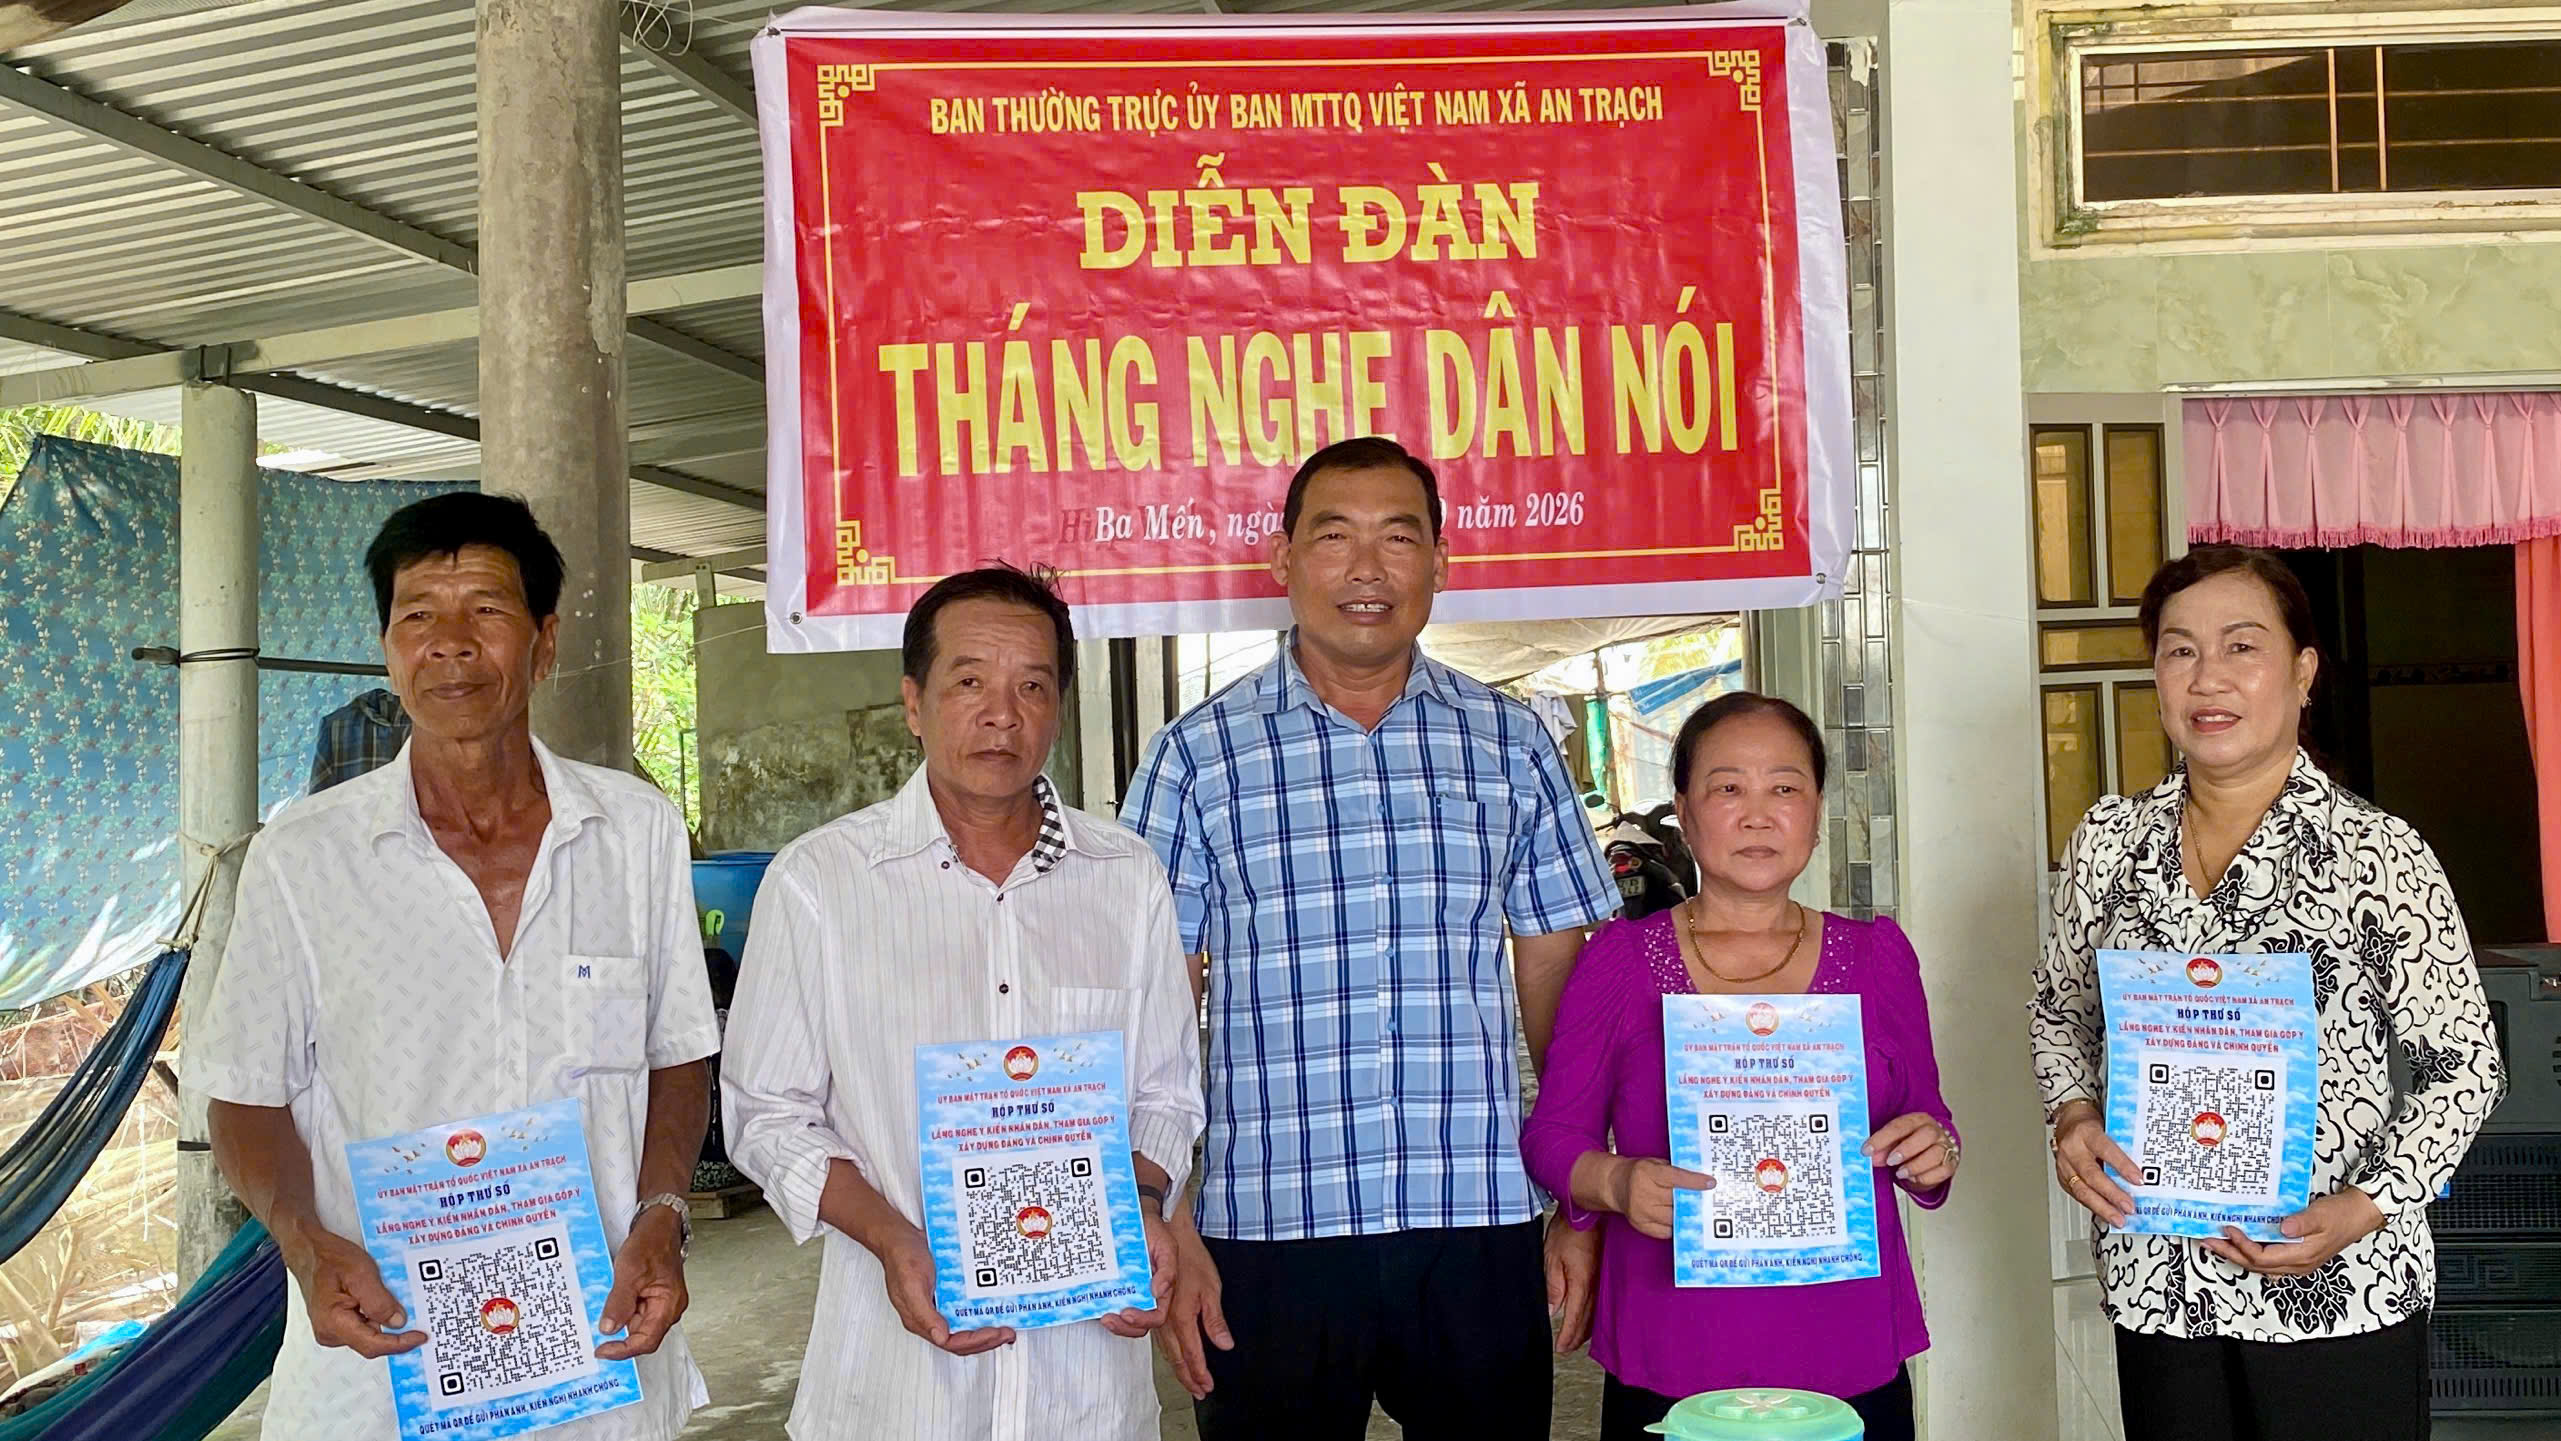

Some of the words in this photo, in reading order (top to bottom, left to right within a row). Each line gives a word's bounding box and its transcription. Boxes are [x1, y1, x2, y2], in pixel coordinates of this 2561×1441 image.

[931, 98, 985, 135] BAN
[993, 89, 1100, 133] THƯỜNG
[1109, 88, 1178, 138] TRỰC
[1188, 81, 1217, 130] ỦY
[1231, 93, 1284, 129] BAN
[1290, 93, 1361, 131] MTTQ
[1369, 81, 1424, 133] VIỆT
[1435, 89, 1490, 125] NAM
[1498, 80, 1532, 124] XÃ
[1540, 89, 1572, 122] AN
[1579, 87, 1663, 129] TRẠCH
[1076, 152, 1314, 270] DIỄN
[1339, 162, 1539, 264] ĐÀN
[878, 302, 1162, 477] THÁNG
[1187, 331, 1397, 467] NGHE
[1425, 290, 1585, 460] DÂN
[1610, 286, 1738, 455] NÓI
[1095, 507, 1132, 542] Ba
[1144, 497, 1216, 545] Mến,
[1227, 503, 1285, 545] ngà
[1457, 495, 1517, 529] năm
[1525, 492, 1584, 526] 2026
[2177, 1006, 2199, 1021] HỘP
[2202, 1008, 2224, 1020] THƯ
[2227, 1007, 2240, 1020] SỐ
[992, 1104, 1014, 1120] HỘP
[1017, 1100, 1038, 1115] THƯ
[1042, 1099, 1054, 1113] SỐ
[403, 1219, 427, 1230] NGHE
[511, 1199, 536, 1211] THAM
[538, 1194, 553, 1205] GIA
[440, 1193, 464, 1209] HỘP
[468, 1184, 492, 1202] THƯ
[495, 1179, 510, 1197] SỐ
